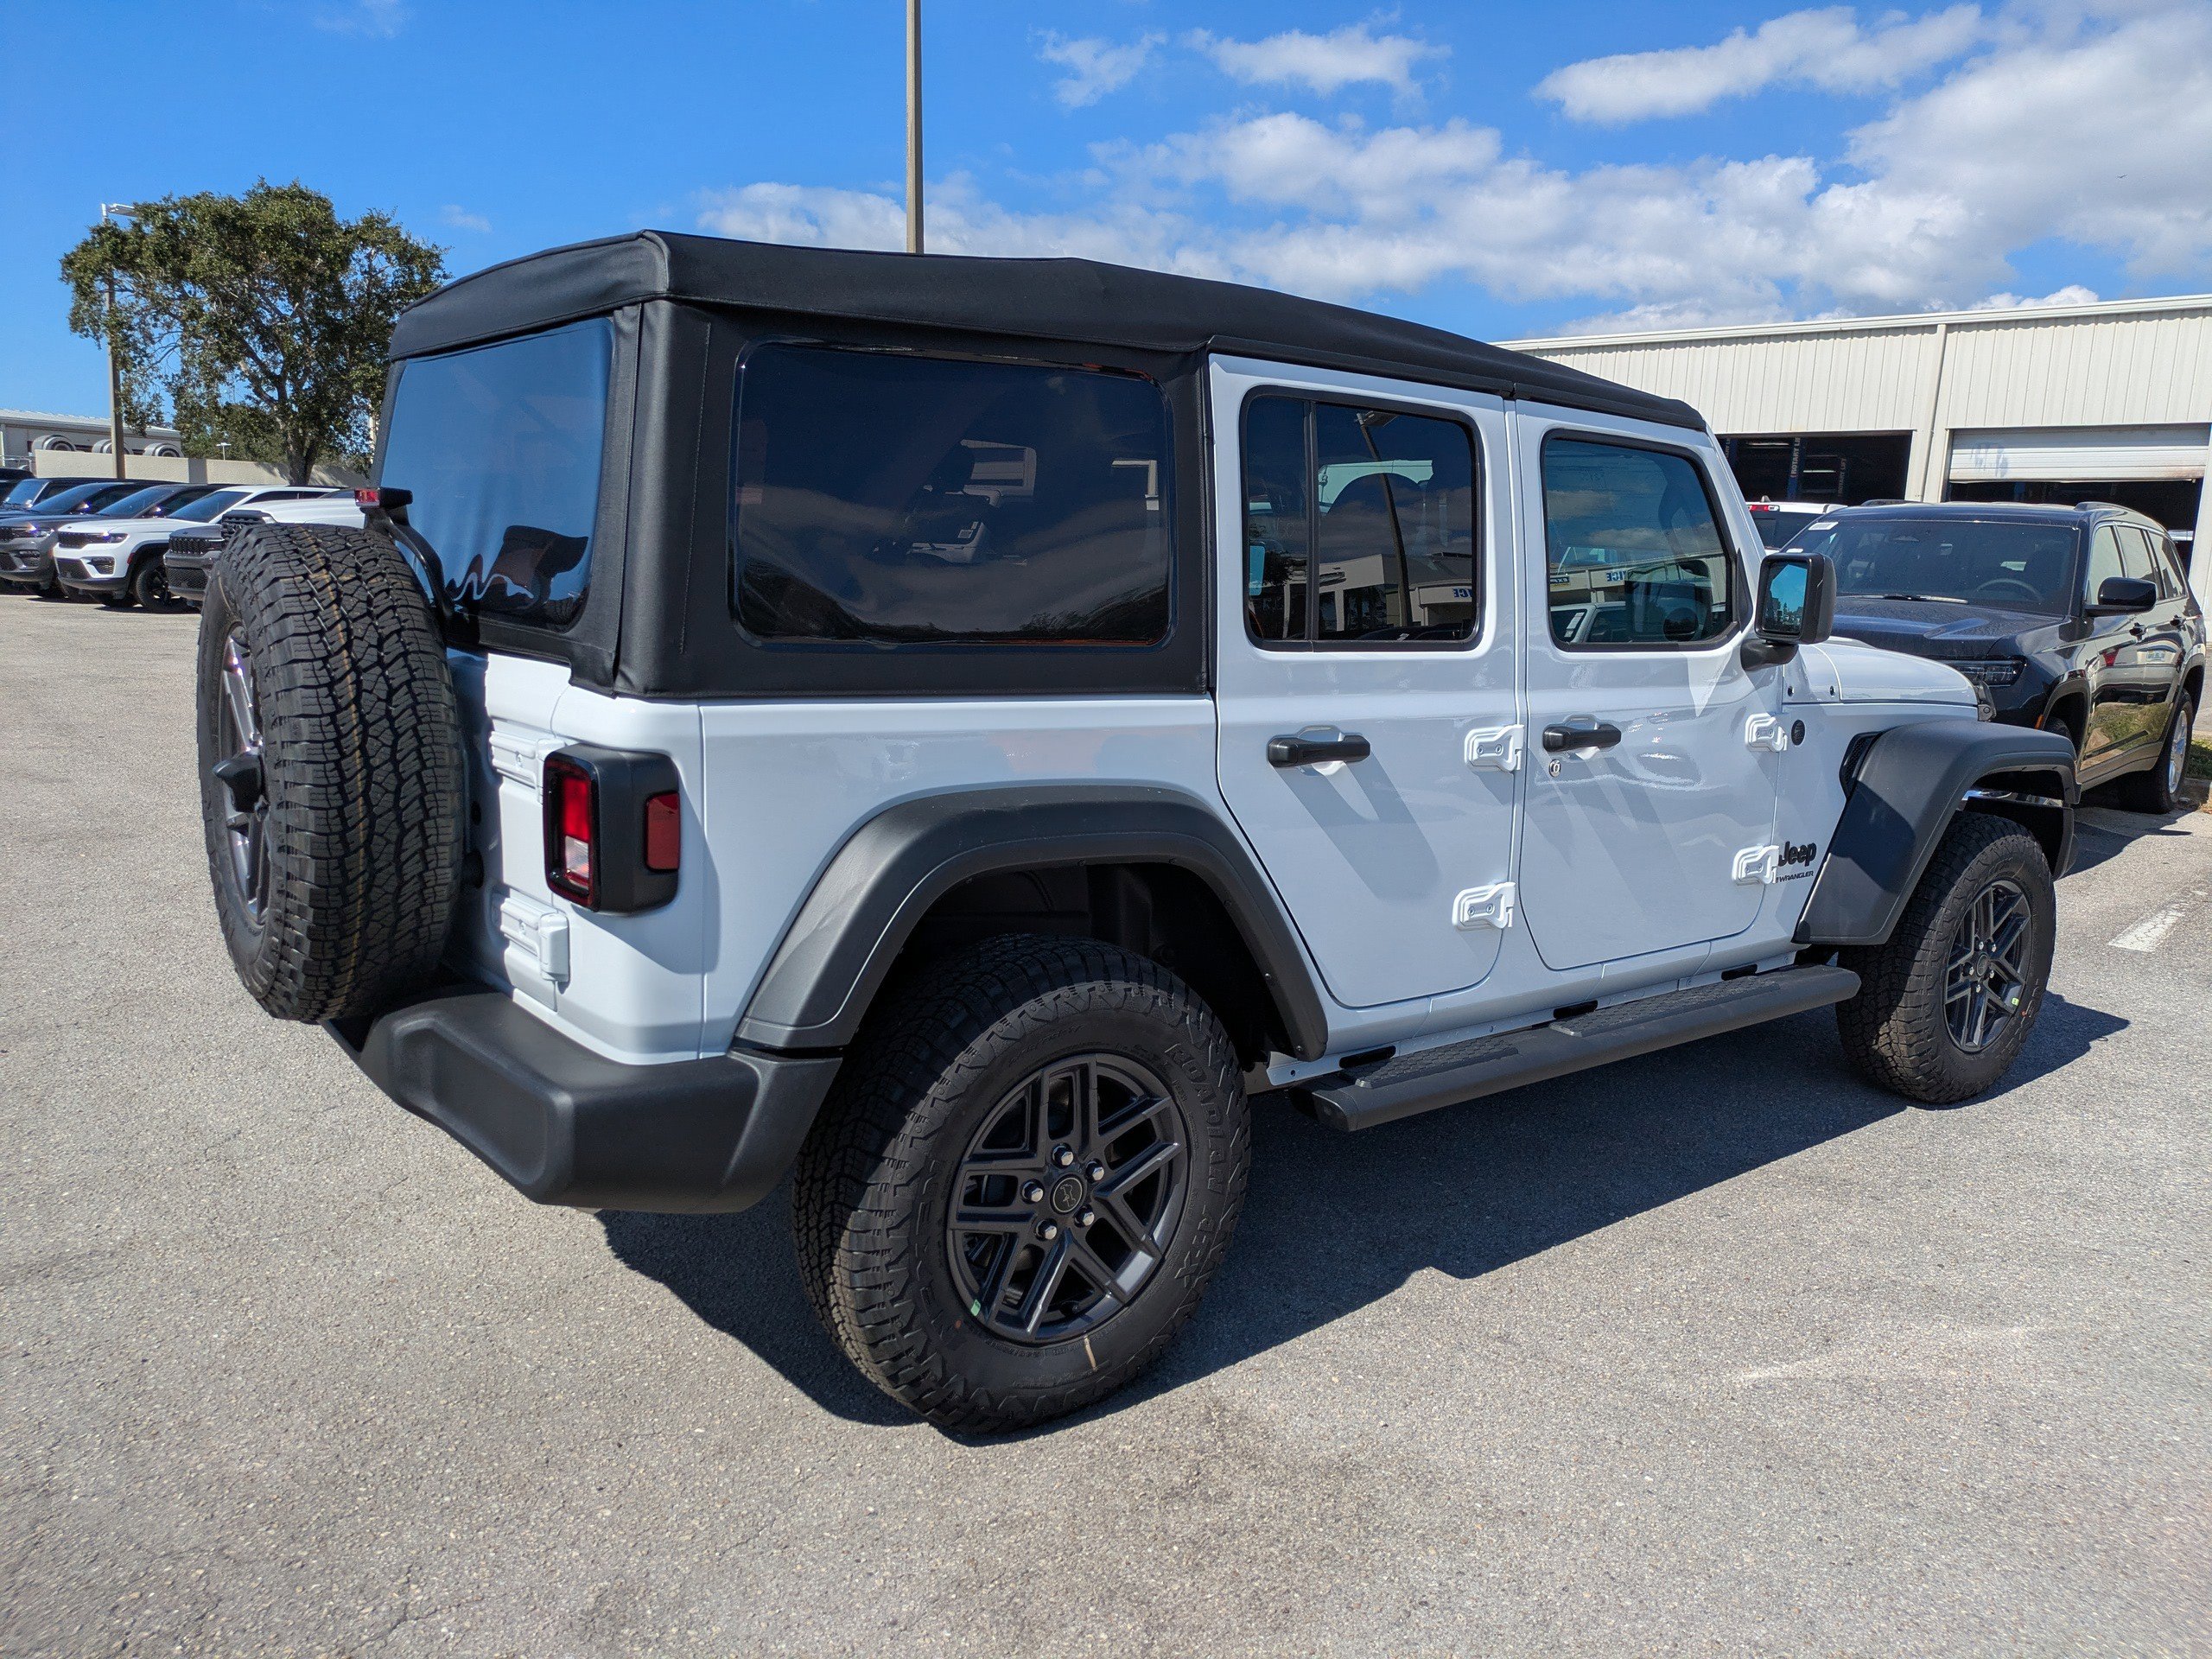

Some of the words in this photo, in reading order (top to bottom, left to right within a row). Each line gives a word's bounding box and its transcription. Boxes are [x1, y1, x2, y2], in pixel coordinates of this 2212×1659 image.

[1790, 448, 1800, 474] ROTARY
[1778, 841, 1817, 867] Jeep
[1780, 871, 1814, 882] WRANGLER
[1164, 1042, 1227, 1193] ROADIAN
